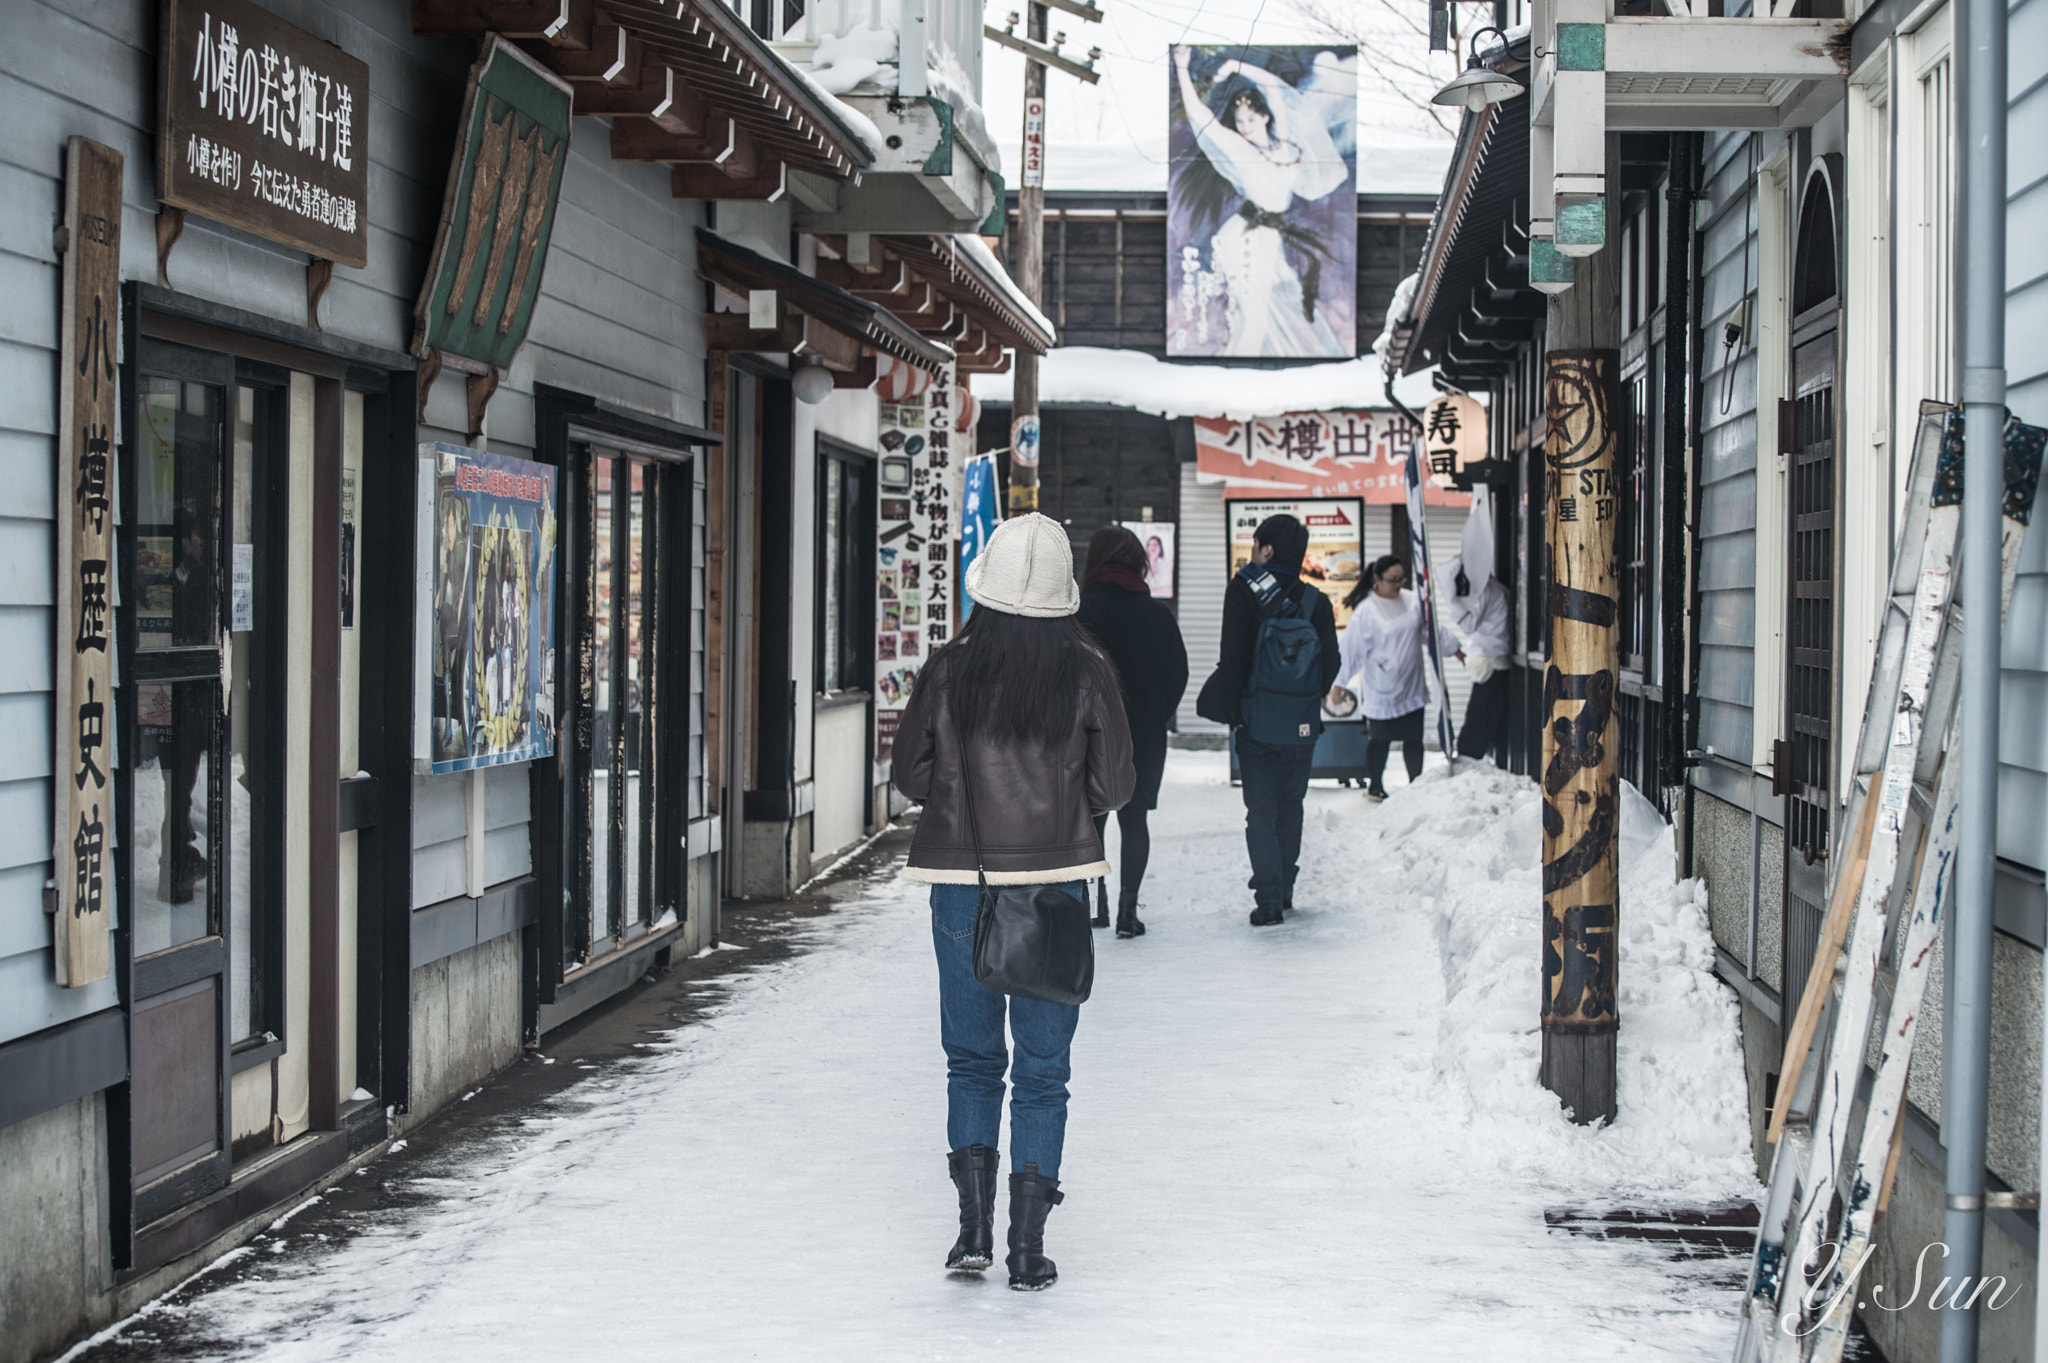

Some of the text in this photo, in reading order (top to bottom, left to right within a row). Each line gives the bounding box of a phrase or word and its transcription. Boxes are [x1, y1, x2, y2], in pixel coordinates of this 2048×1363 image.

[193, 12, 352, 172] 小樽の若き獅子達
[81, 212, 118, 248] MUSEUM
[187, 133, 357, 234] 小樽を作り 今に伝えた勇者達の記録
[1428, 402, 1461, 482] 寿司
[1580, 469, 1618, 496] STA
[928, 368, 950, 656] 写真と雑誌・小物が語る大昭和
[74, 294, 113, 917] 小樽歴史館
